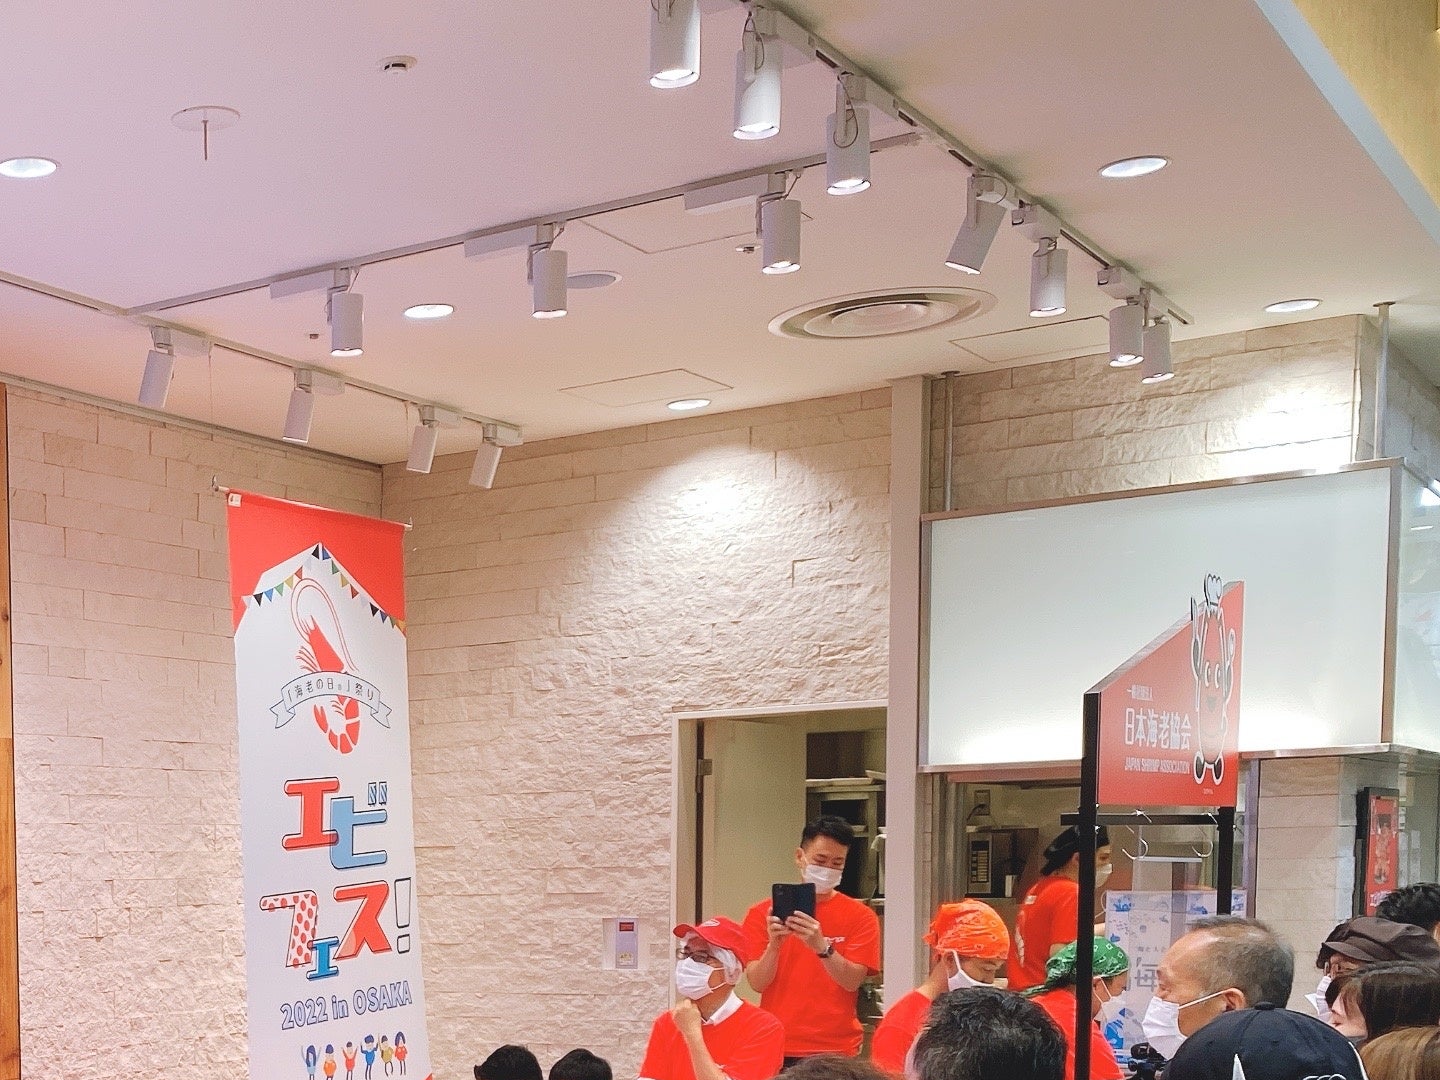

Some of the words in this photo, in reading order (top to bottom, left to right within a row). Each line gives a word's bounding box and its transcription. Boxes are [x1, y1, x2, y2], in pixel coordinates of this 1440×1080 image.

[1124, 707, 1192, 751] 日本海老協会
[281, 776, 388, 871] エビ
[279, 996, 329, 1031] 2022
[330, 993, 350, 1021] in
[352, 980, 414, 1018] OSAKA
